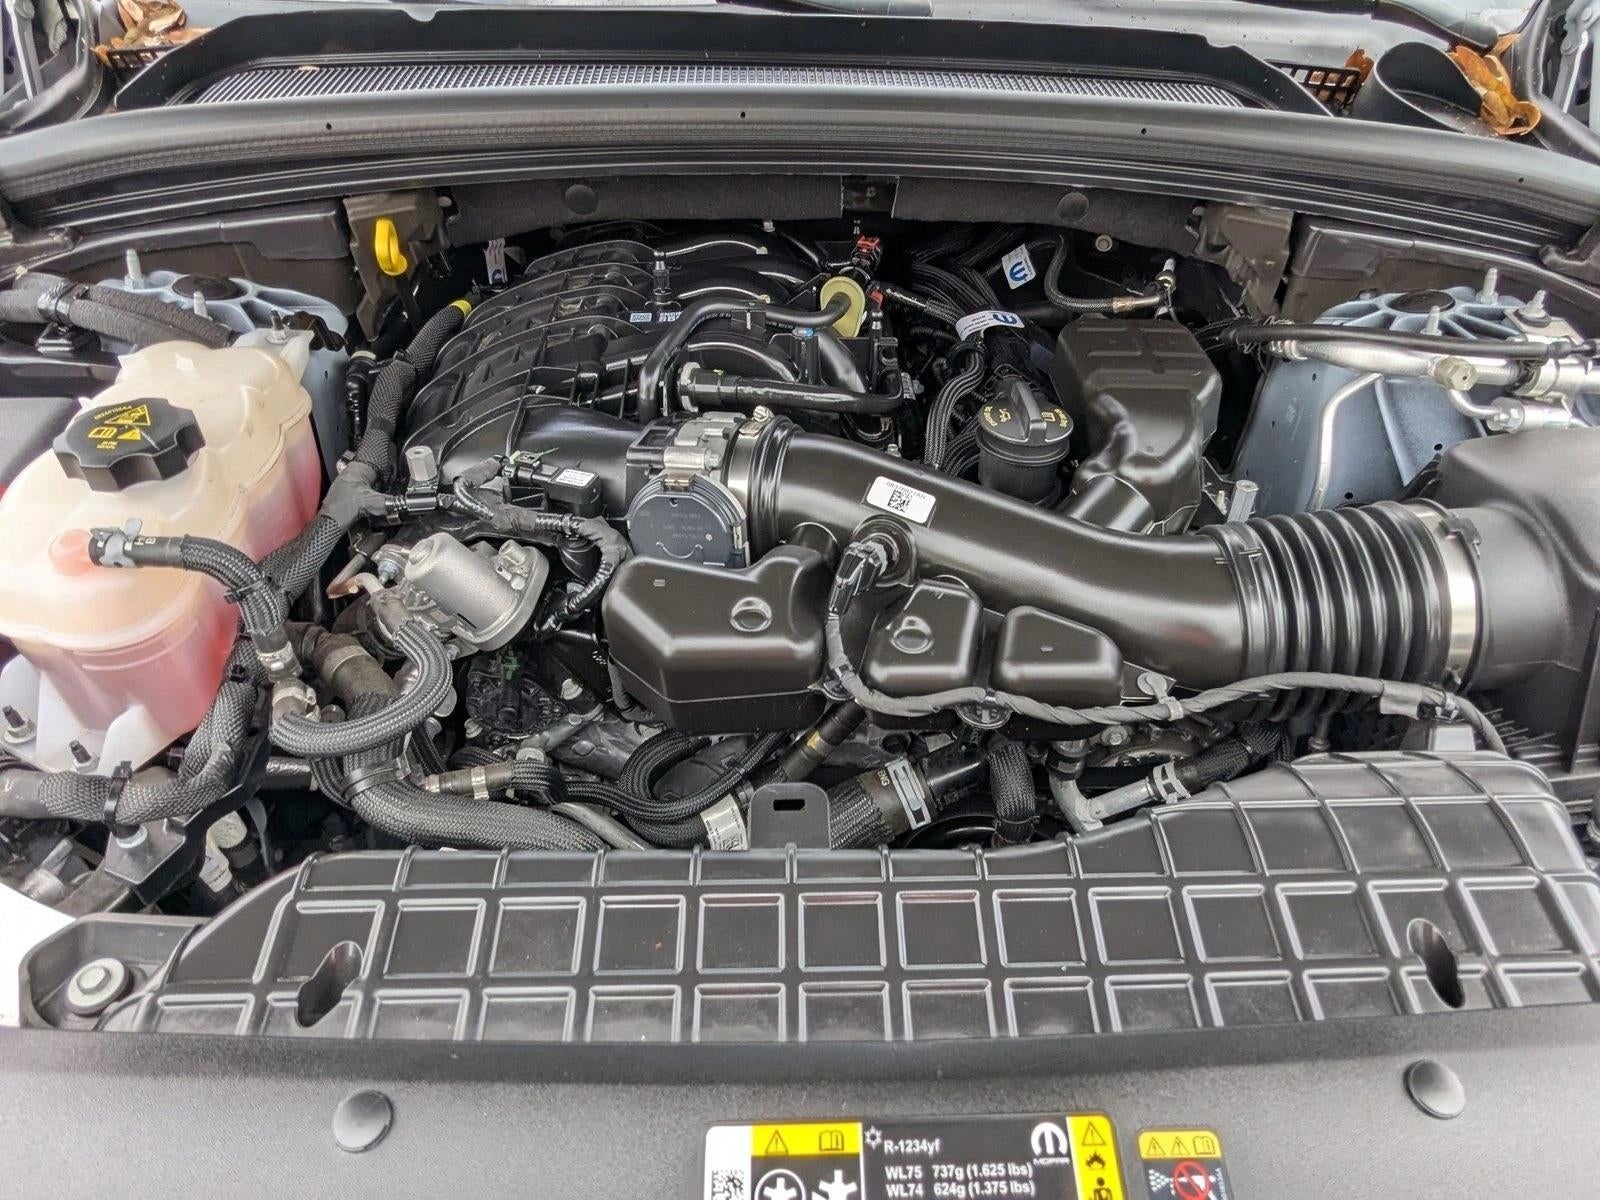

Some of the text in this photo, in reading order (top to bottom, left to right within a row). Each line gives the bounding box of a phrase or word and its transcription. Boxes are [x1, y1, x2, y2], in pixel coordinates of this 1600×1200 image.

[877, 770, 890, 786] ENG
[884, 1139, 941, 1155] R-1234yf
[885, 1162, 1034, 1180] WL75 737g (1.625 lbs)
[886, 1181, 1036, 1198] WL74 624g (1.375 lbs)
